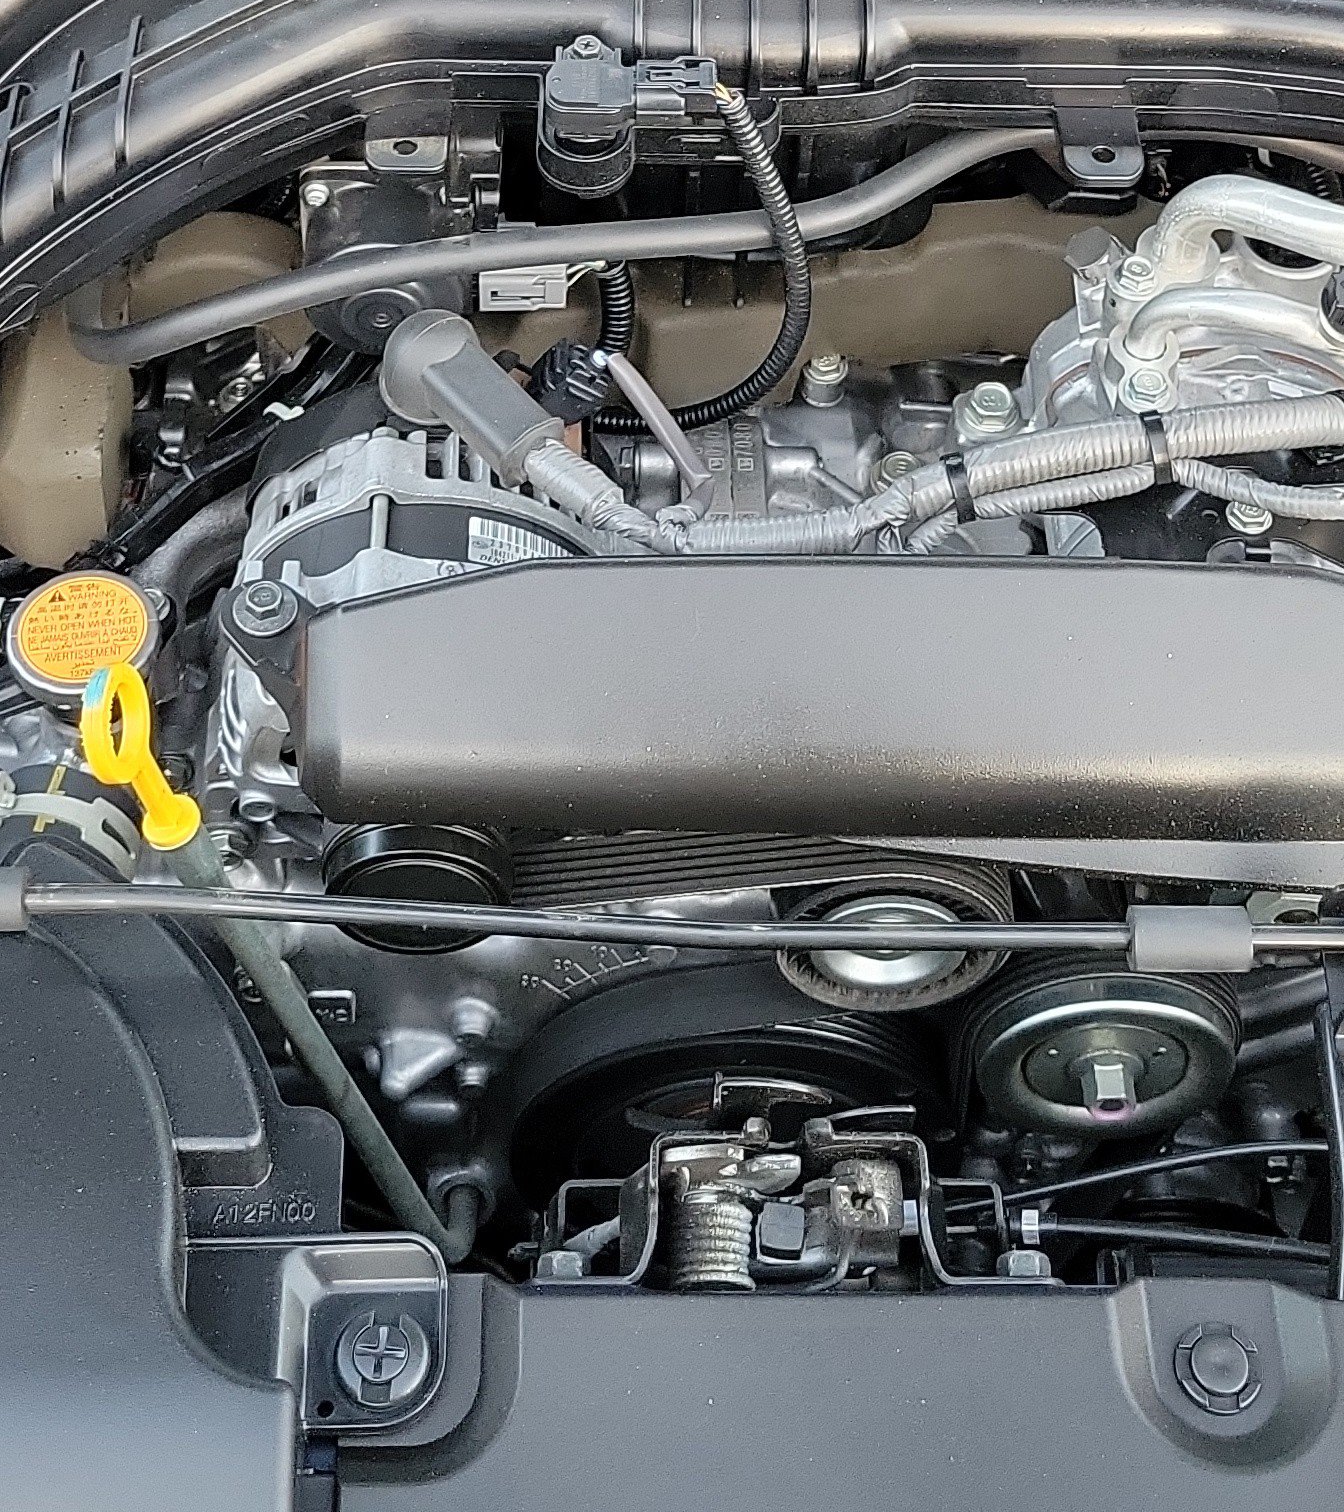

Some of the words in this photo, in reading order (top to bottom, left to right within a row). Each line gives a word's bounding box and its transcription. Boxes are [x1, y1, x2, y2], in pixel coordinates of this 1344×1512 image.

[68, 590, 117, 601] WARNING
[27, 624, 57, 635] NEVER
[60, 621, 85, 633] OPEN
[88, 618, 117, 630] WHEN
[28, 636, 39, 645] NE
[44, 647, 123, 664] AVERTISSEMENT
